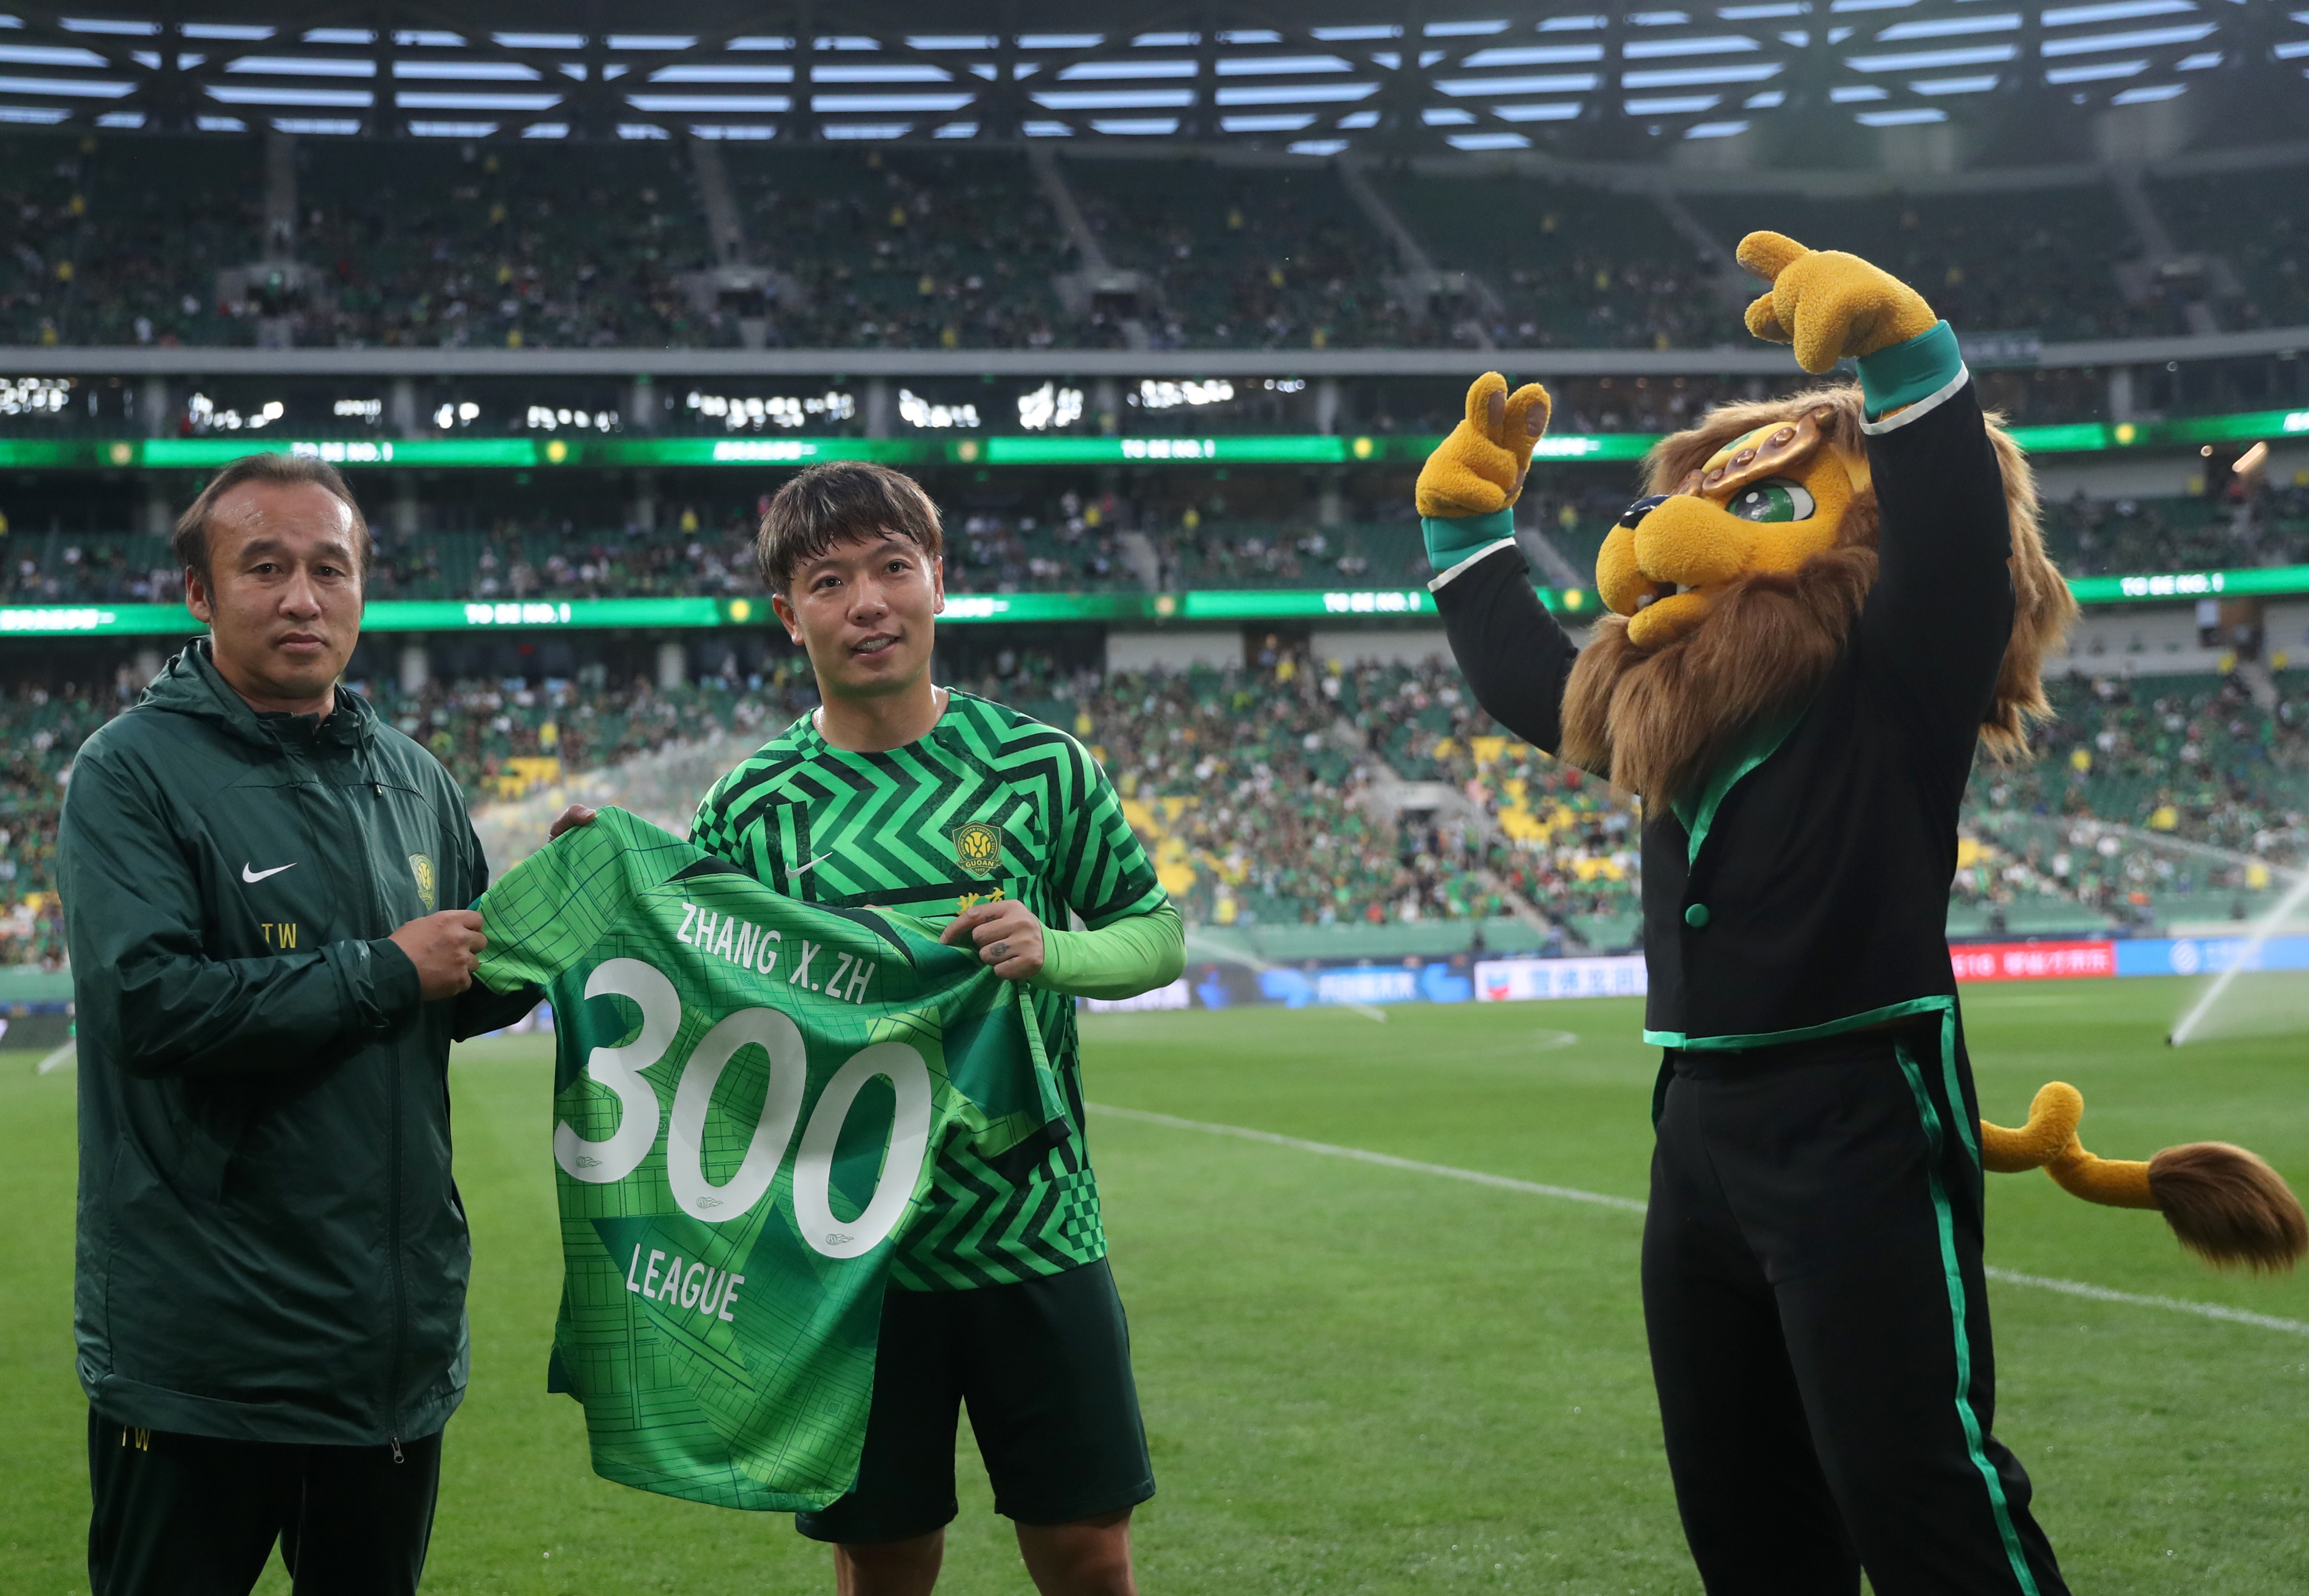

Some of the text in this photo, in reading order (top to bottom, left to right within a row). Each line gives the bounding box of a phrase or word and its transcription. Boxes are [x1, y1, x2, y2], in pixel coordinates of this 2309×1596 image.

[962, 828, 976, 838] GUOAN
[977, 828, 994, 842] FOOTBALL
[677, 902, 781, 975] ZHANG
[553, 957, 932, 1259] 300
[626, 1243, 745, 1322] LEAGUE
